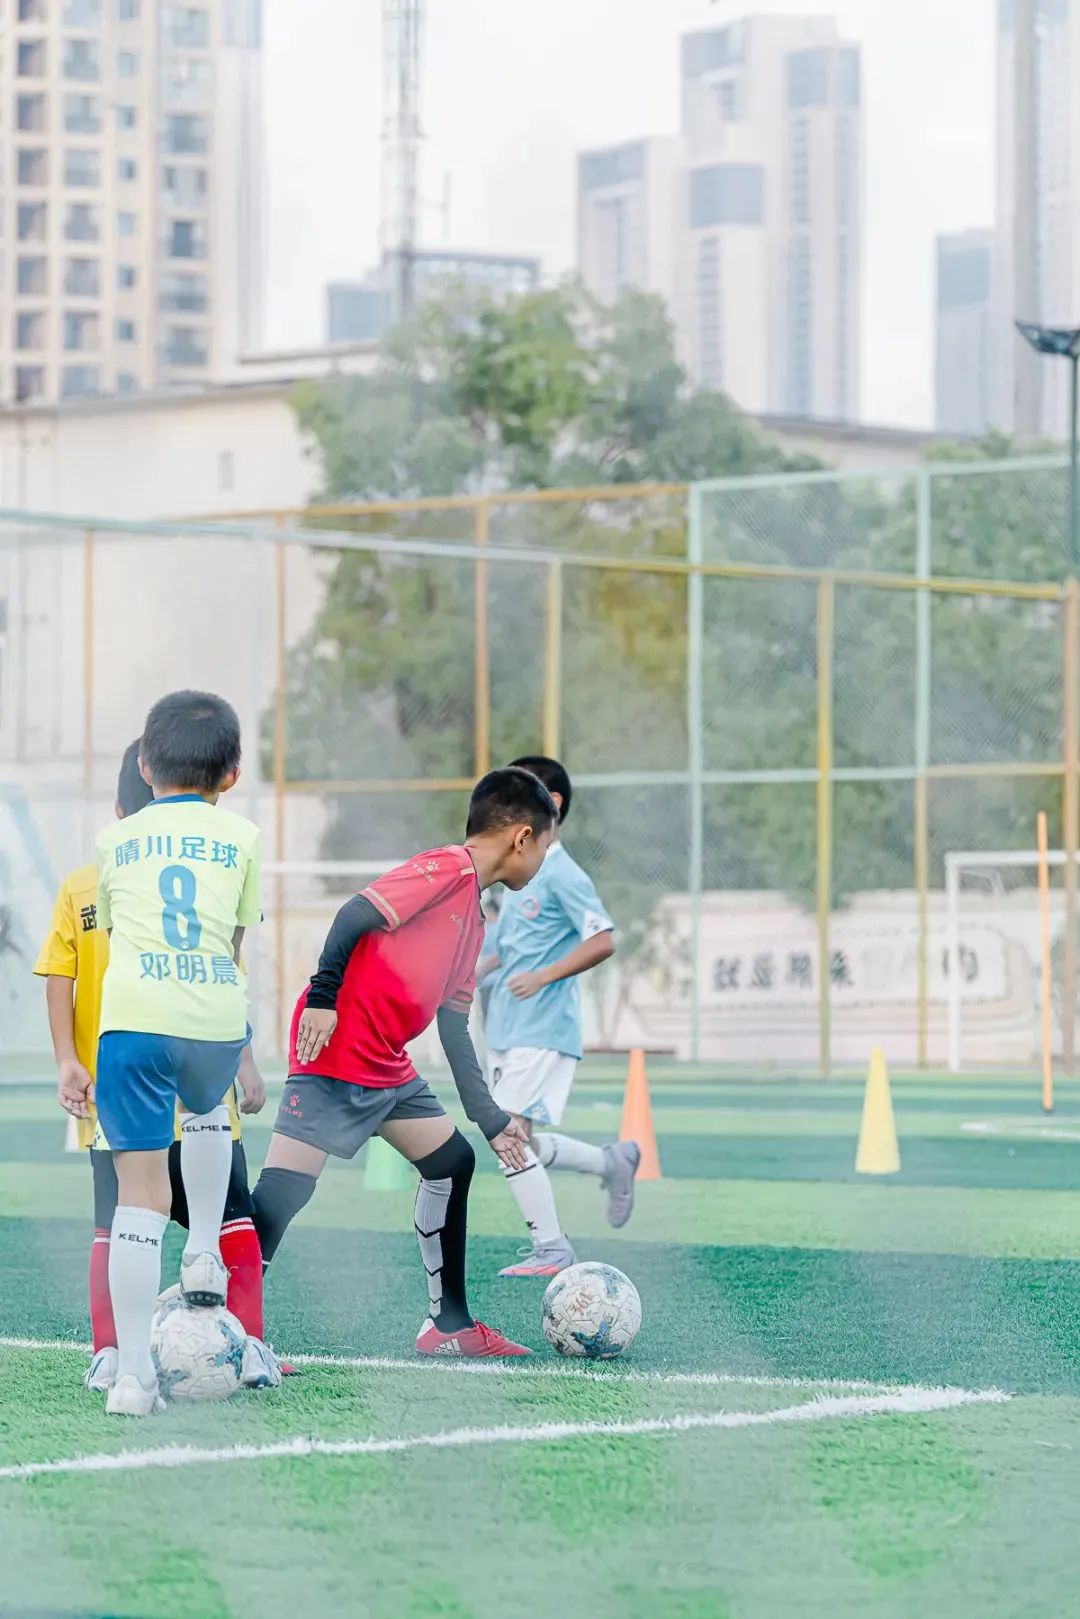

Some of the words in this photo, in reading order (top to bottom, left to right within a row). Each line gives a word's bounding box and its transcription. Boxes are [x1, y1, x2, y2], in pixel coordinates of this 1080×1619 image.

[115, 835, 239, 868] 晴川足球
[159, 865, 202, 952] 8
[140, 952, 240, 986] 邓明晨
